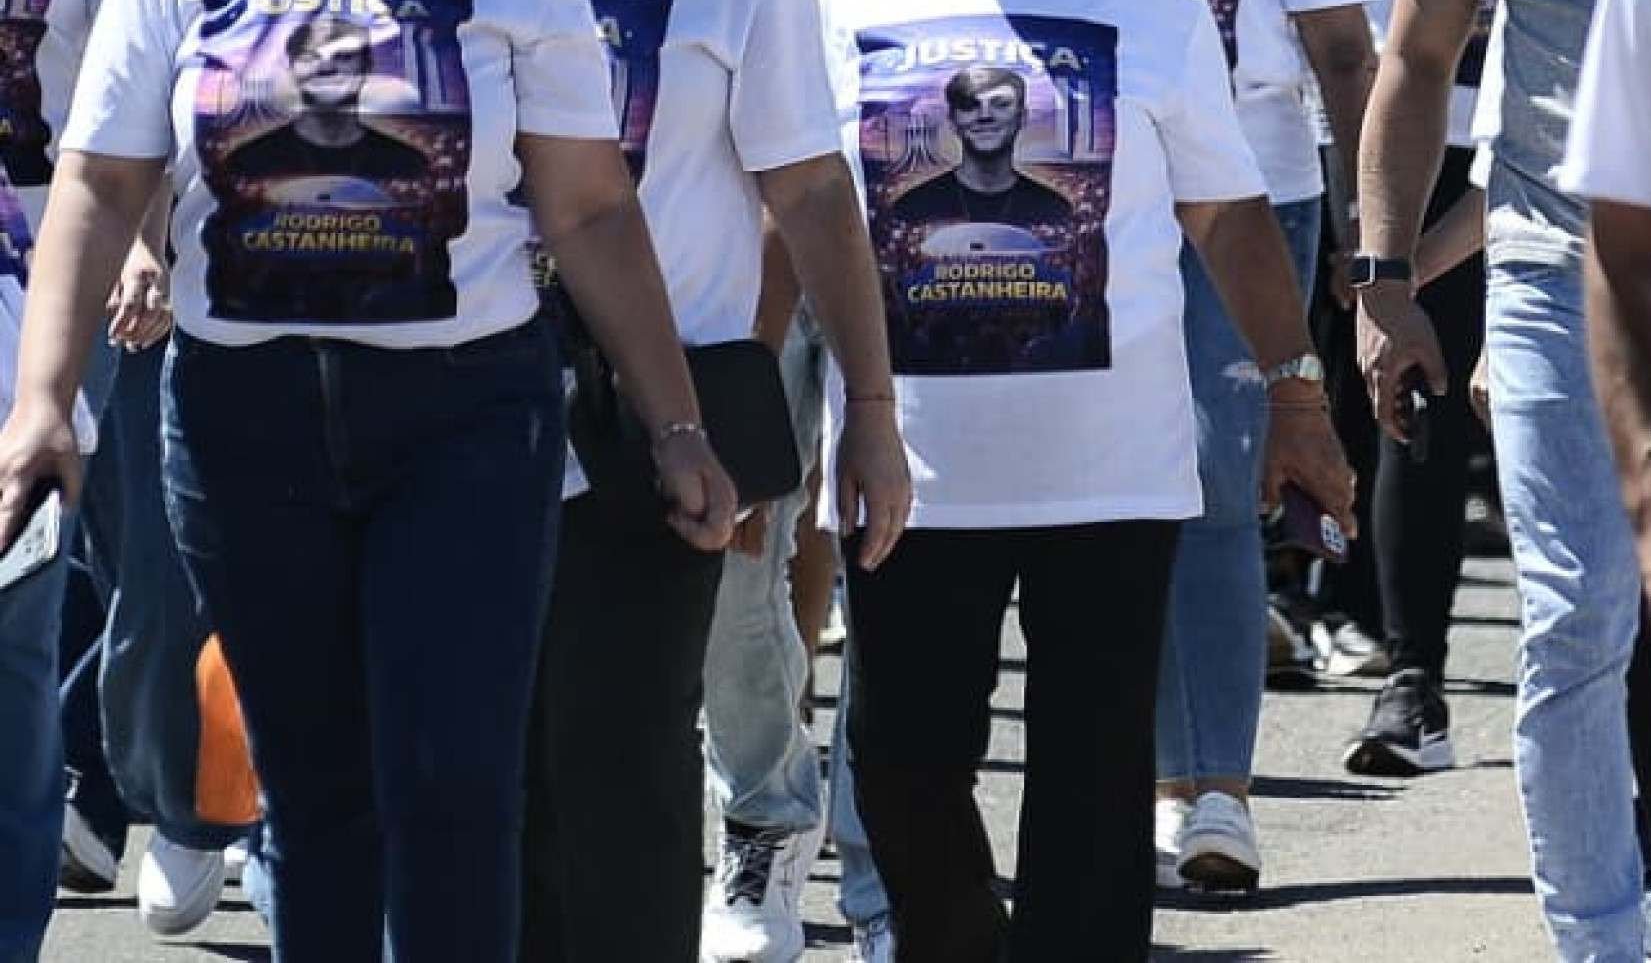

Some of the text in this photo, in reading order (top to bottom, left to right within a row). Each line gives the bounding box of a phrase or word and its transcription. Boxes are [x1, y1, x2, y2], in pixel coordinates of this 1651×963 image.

[895, 38, 1082, 73] JUSTIÇA
[933, 263, 1035, 280] RODRIGO
[906, 281, 1068, 303] CASTANHEIRA
